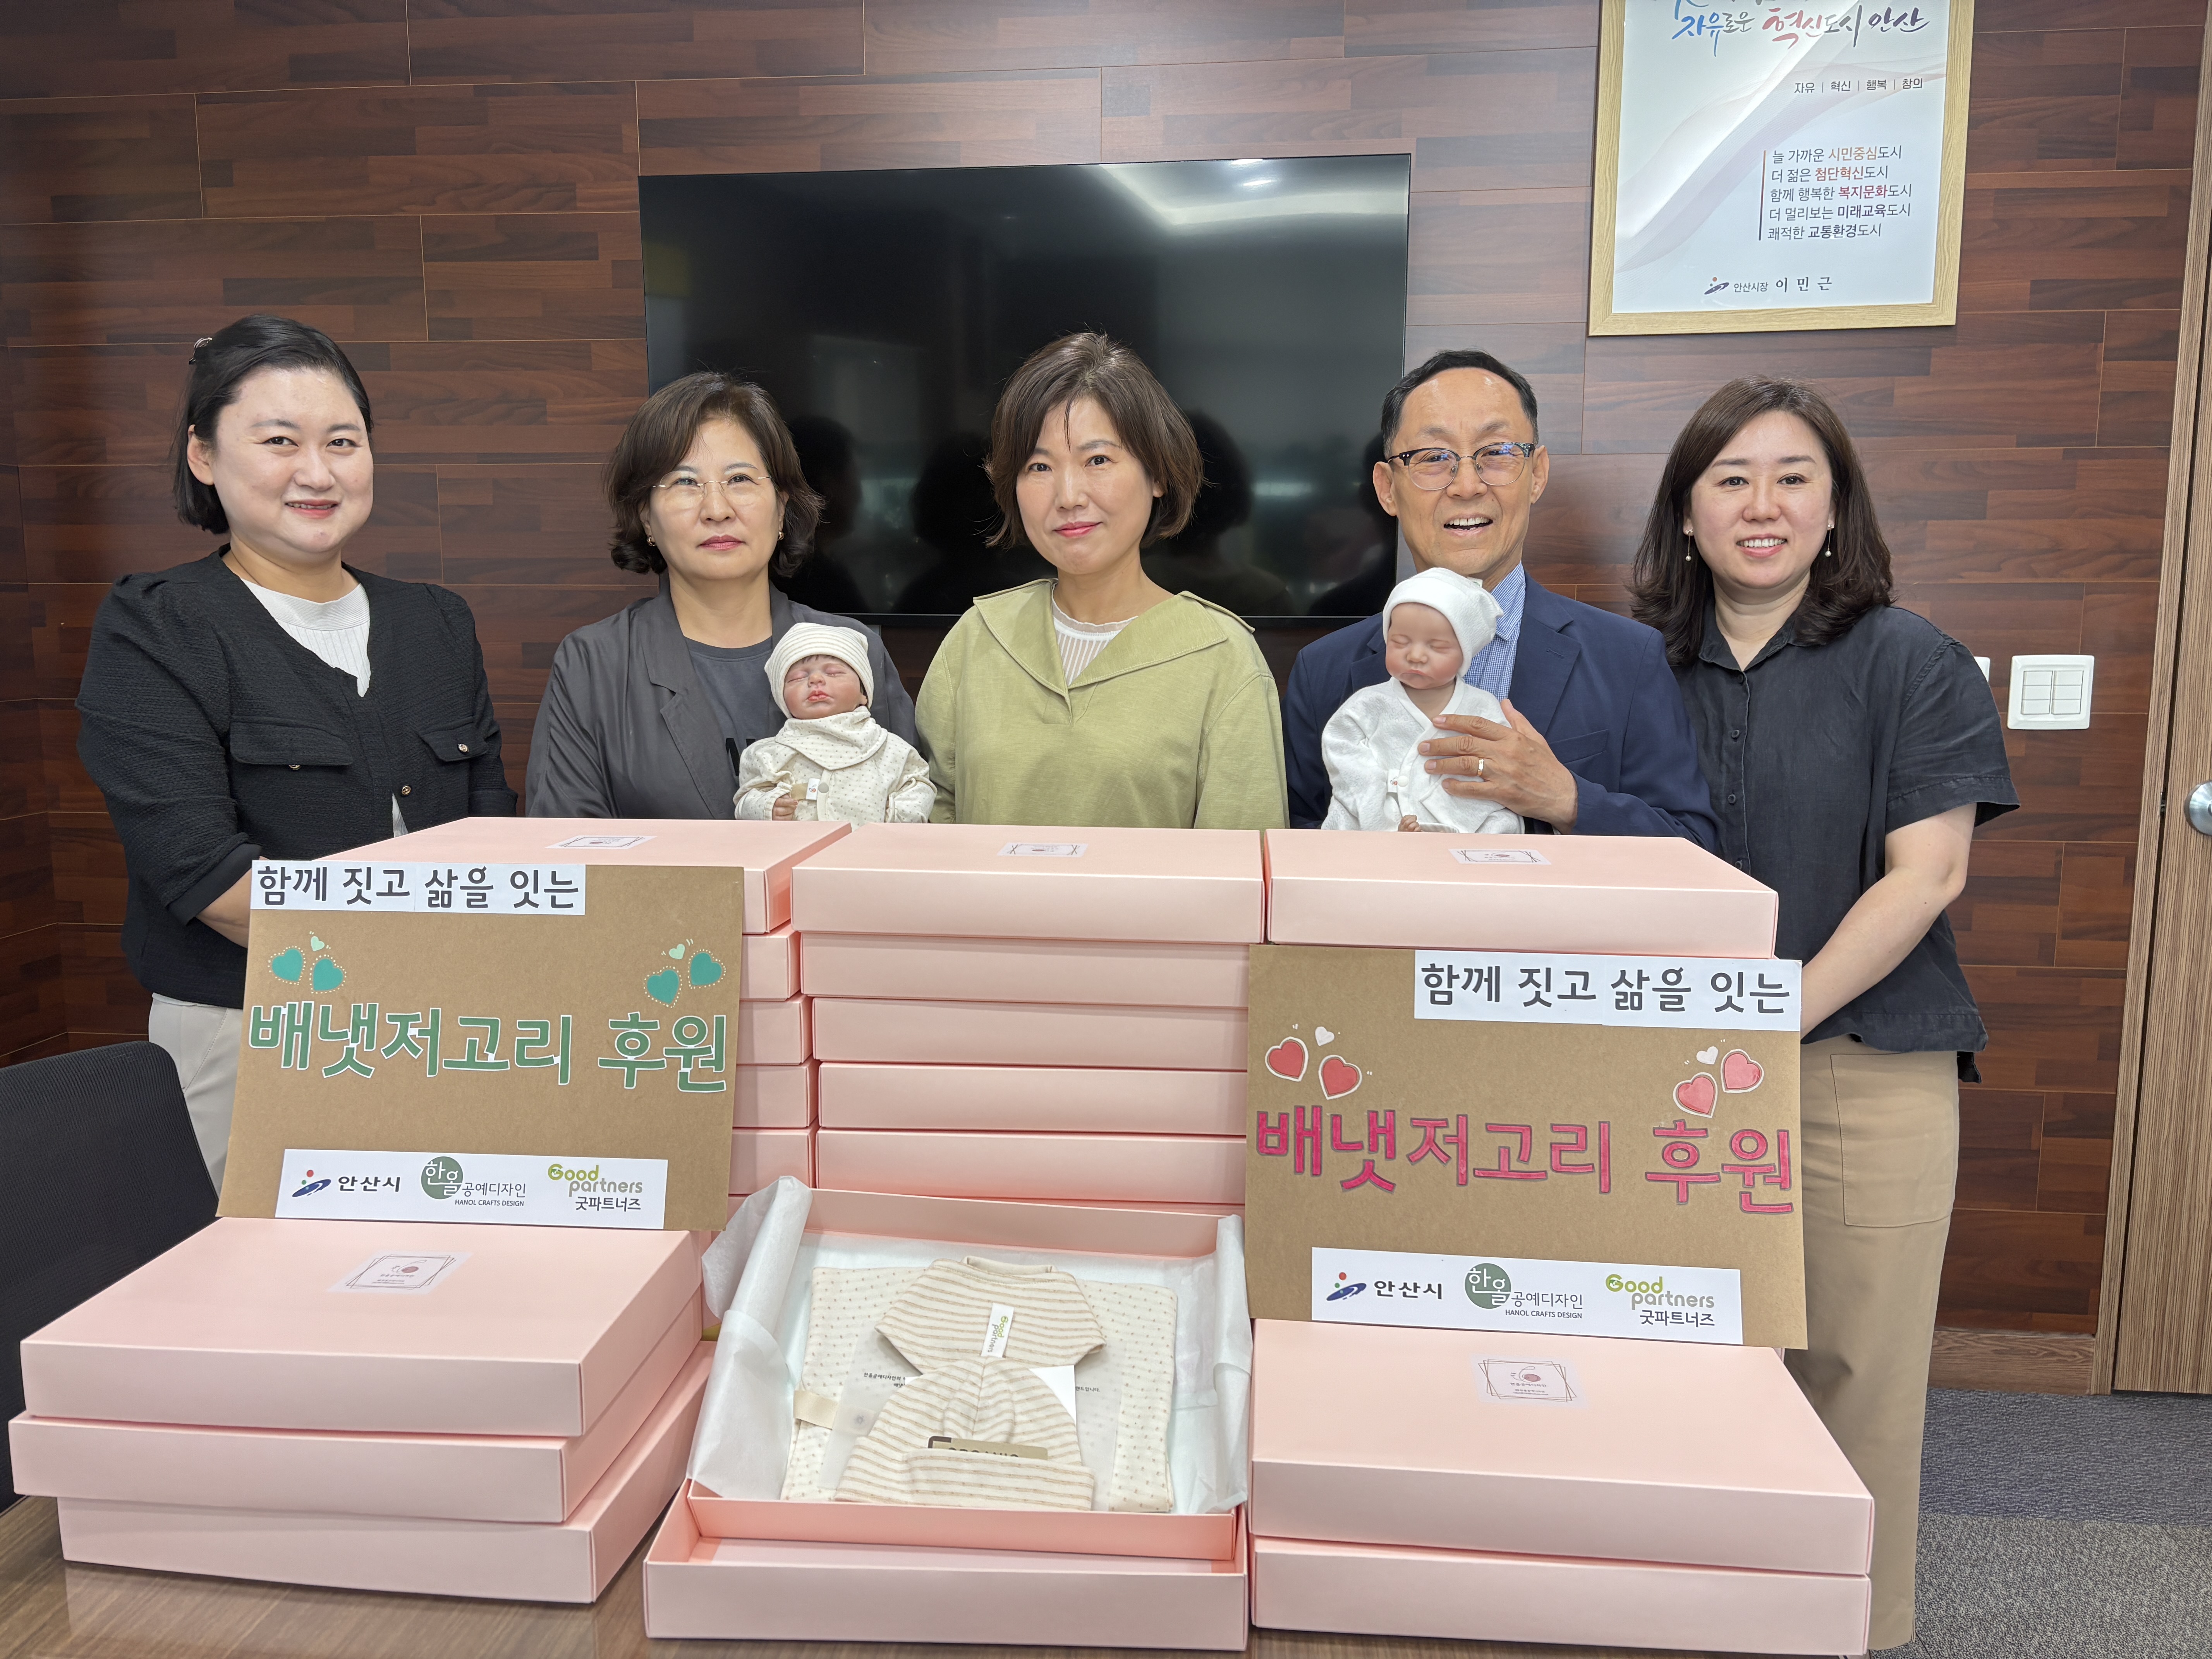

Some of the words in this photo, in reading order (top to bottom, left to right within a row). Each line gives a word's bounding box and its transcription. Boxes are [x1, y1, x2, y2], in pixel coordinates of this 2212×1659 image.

[1672, 11, 1755, 57] 자유로운
[1762, 5, 1862, 49] 혁신도시
[1869, 7, 1930, 32] 안산
[1795, 83, 1815, 93] 자유
[1831, 81, 1850, 91] 혁신
[1867, 80, 1887, 90] 행복
[1903, 78, 1922, 89] 창의
[1772, 150, 1784, 163] 늘
[1788, 149, 1824, 163] 가까운
[1828, 145, 1901, 161] 시민중심도시
[1772, 169, 1782, 183] 더
[1788, 168, 1811, 182] 젊은
[1815, 165, 1887, 181] 첨단혁신도시
[1771, 188, 1794, 202] 함께
[1798, 187, 1835, 201] 행복한
[1838, 184, 1911, 199] 복지문화도시
[1770, 208, 1780, 221] 더
[1786, 206, 1833, 221] 멀리보는
[1838, 203, 1910, 218] 미래교육도시
[1768, 226, 1805, 240] 쾌적한
[1808, 223, 1881, 239] 교통환경도시
[1734, 282, 1768, 292] 안산시장
[258, 866, 327, 905] 함께
[343, 867, 410, 905] 짓고
[425, 866, 493, 908] 삶을
[510, 870, 578, 908] 잇는
[1421, 963, 1500, 1005] 함께
[1518, 967, 1596, 1007] 짓고
[1611, 967, 1691, 1012] 삶을
[1711, 972, 1790, 1013] 잇는
[249, 1001, 572, 1085] 배냇저고리
[598, 1011, 726, 1092] 후원
[1256, 1105, 1611, 1194] 배냇저고리
[1644, 1120, 1794, 1214] 후원
[548, 1163, 599, 1182] Good
[338, 1176, 400, 1192] 안산시
[568, 1178, 642, 1197] partners
[575, 1197, 641, 1212] 굿파트너즈
[1374, 1281, 1441, 1299] 안산시
[1606, 1274, 1663, 1294] Good
[1632, 1290, 1714, 1310] partners
[997, 1316, 1008, 1338] Good
[1640, 1310, 1715, 1327] 굿파트너즈
[988, 1324, 999, 1353] partners
